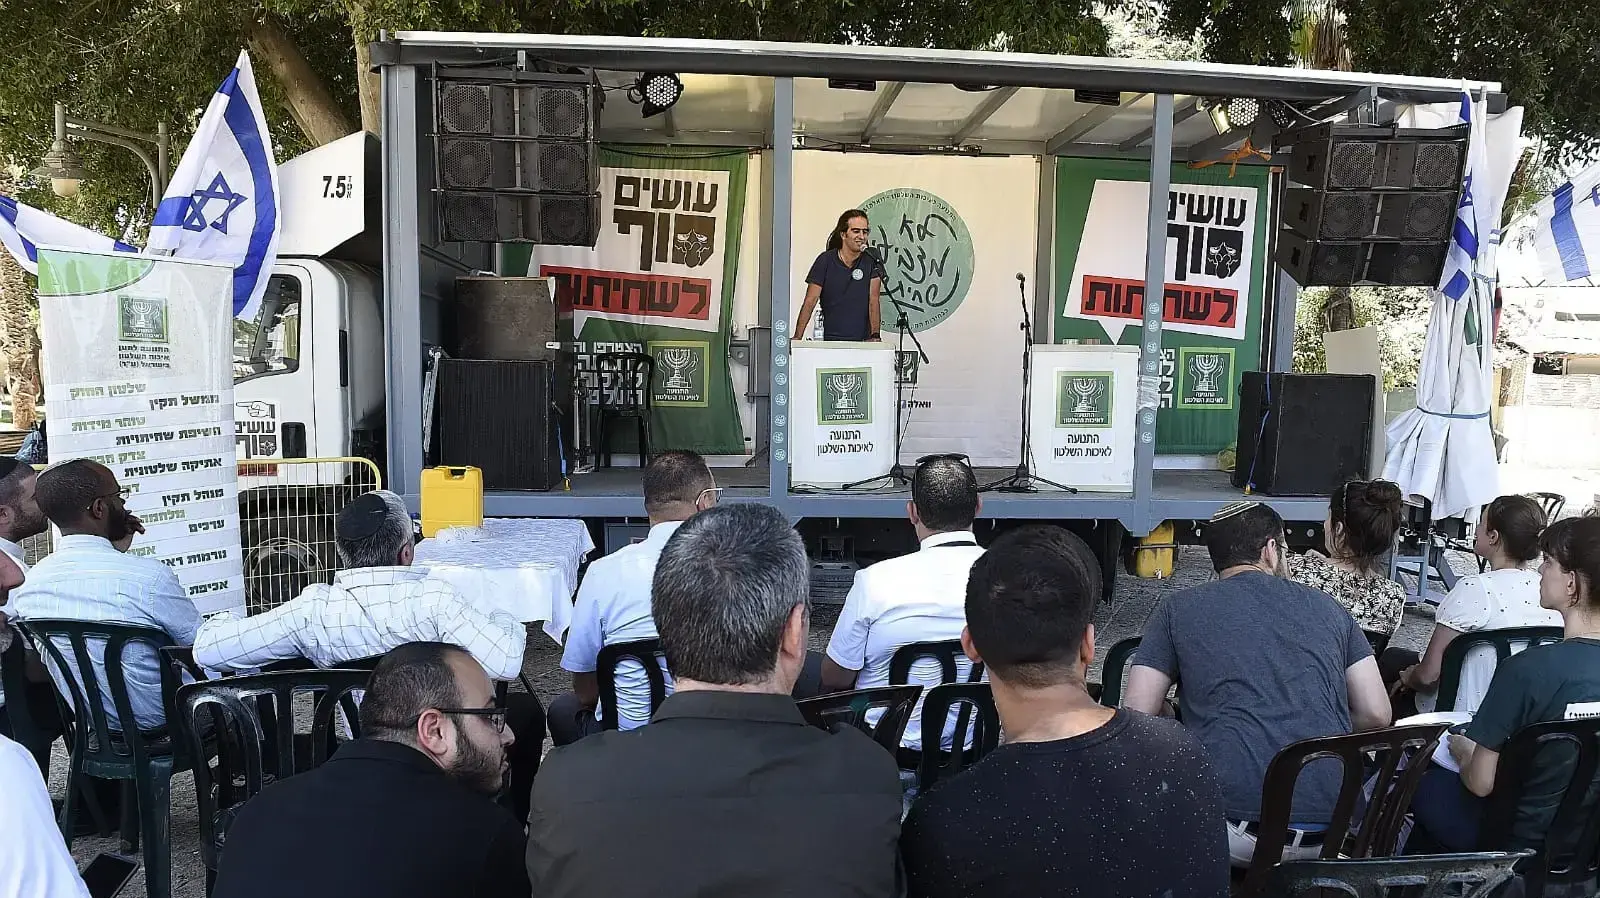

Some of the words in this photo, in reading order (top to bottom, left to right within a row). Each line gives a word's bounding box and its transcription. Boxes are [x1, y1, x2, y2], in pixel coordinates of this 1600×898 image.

[323, 175, 346, 199] 7.5
[613, 175, 718, 213] עושים
[612, 208, 717, 272] סוף
[1084, 281, 1235, 324] לשחתות
[593, 341, 643, 353] הצטרפו
[118, 352, 147, 360] השלטון
[69, 386, 104, 400] החוק
[108, 382, 147, 397] שלטון
[149, 396, 178, 411] תקין
[181, 394, 220, 406] ממשל
[907, 400, 932, 409] וואלה
[71, 419, 112, 432] מידות
[114, 416, 146, 428] טוהר
[115, 431, 174, 446] שחיתויות
[178, 426, 221, 440] חשיפת
[829, 429, 861, 441] התנועה
[1067, 433, 1100, 444] התנועה
[817, 442, 846, 457] השלטון
[847, 441, 874, 453] לאיכות
[1053, 446, 1083, 460] השלטון
[1084, 445, 1113, 457] לאיכות
[118, 450, 146, 465] צדק
[181, 457, 223, 472] אתיקה
[124, 462, 178, 477] שלטונית
[161, 492, 191, 507] תקין
[193, 488, 224, 501] מנהל
[140, 509, 186, 524] מלחמה
[188, 519, 225, 533] ערכים
[187, 549, 228, 564] נורמות
[189, 580, 229, 595] אכיפת
